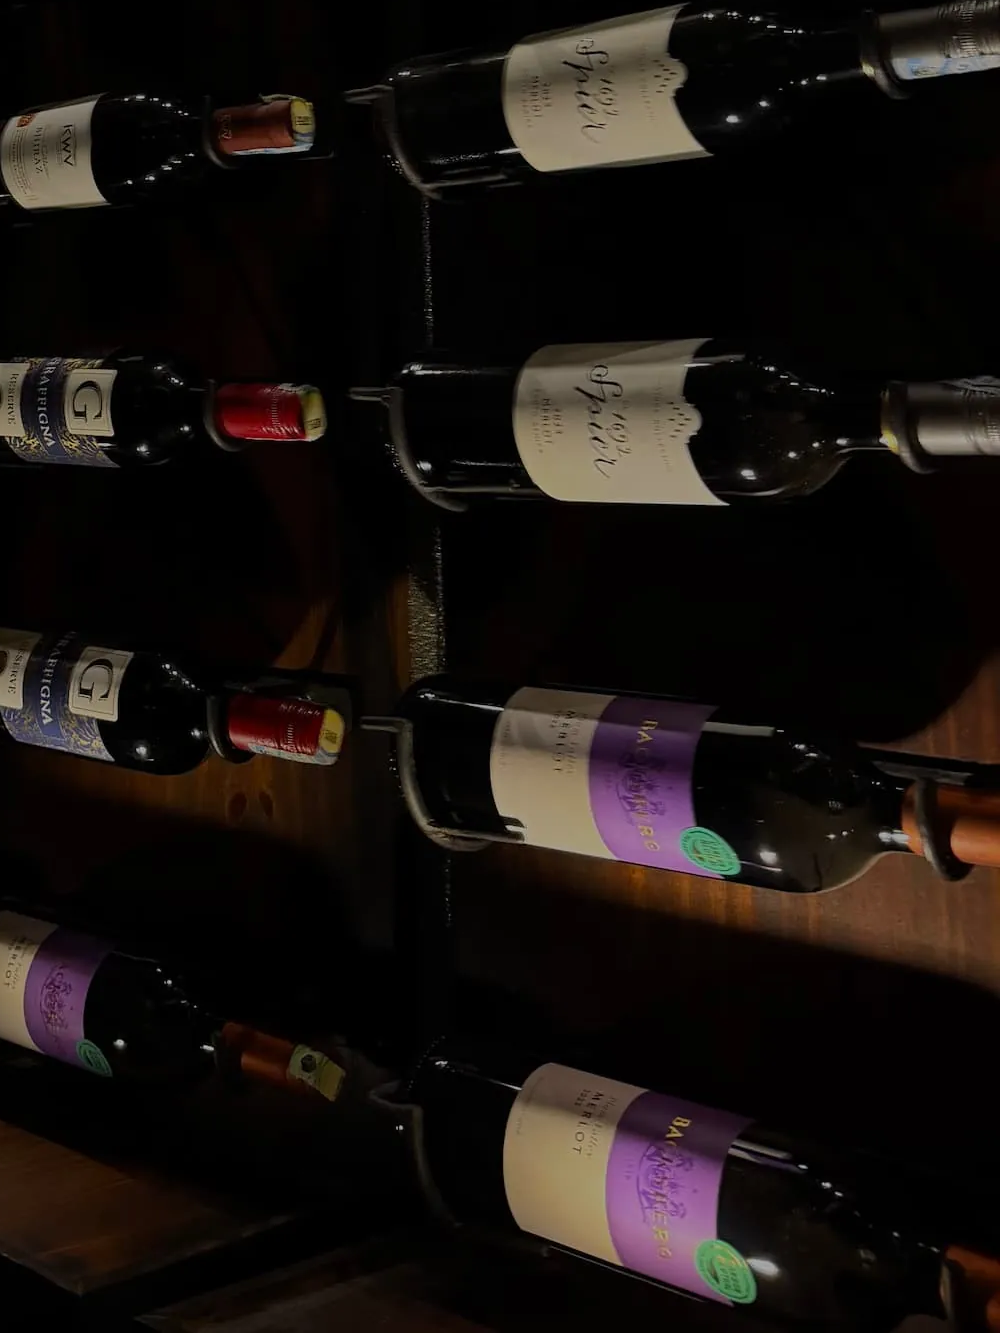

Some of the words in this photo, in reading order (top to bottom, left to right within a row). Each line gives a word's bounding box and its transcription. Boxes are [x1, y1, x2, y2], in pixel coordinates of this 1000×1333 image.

[560, 36, 611, 145] Spier
[61, 123, 75, 168] KWV
[5, 372, 20, 426] RESERVE
[71, 379, 103, 425] G
[571, 363, 625, 480] Spier
[607, 410, 634, 460] 1692
[77, 656, 116, 704] G
[552, 708, 577, 774] MERLOT
[569, 1089, 606, 1156] MERLOT
